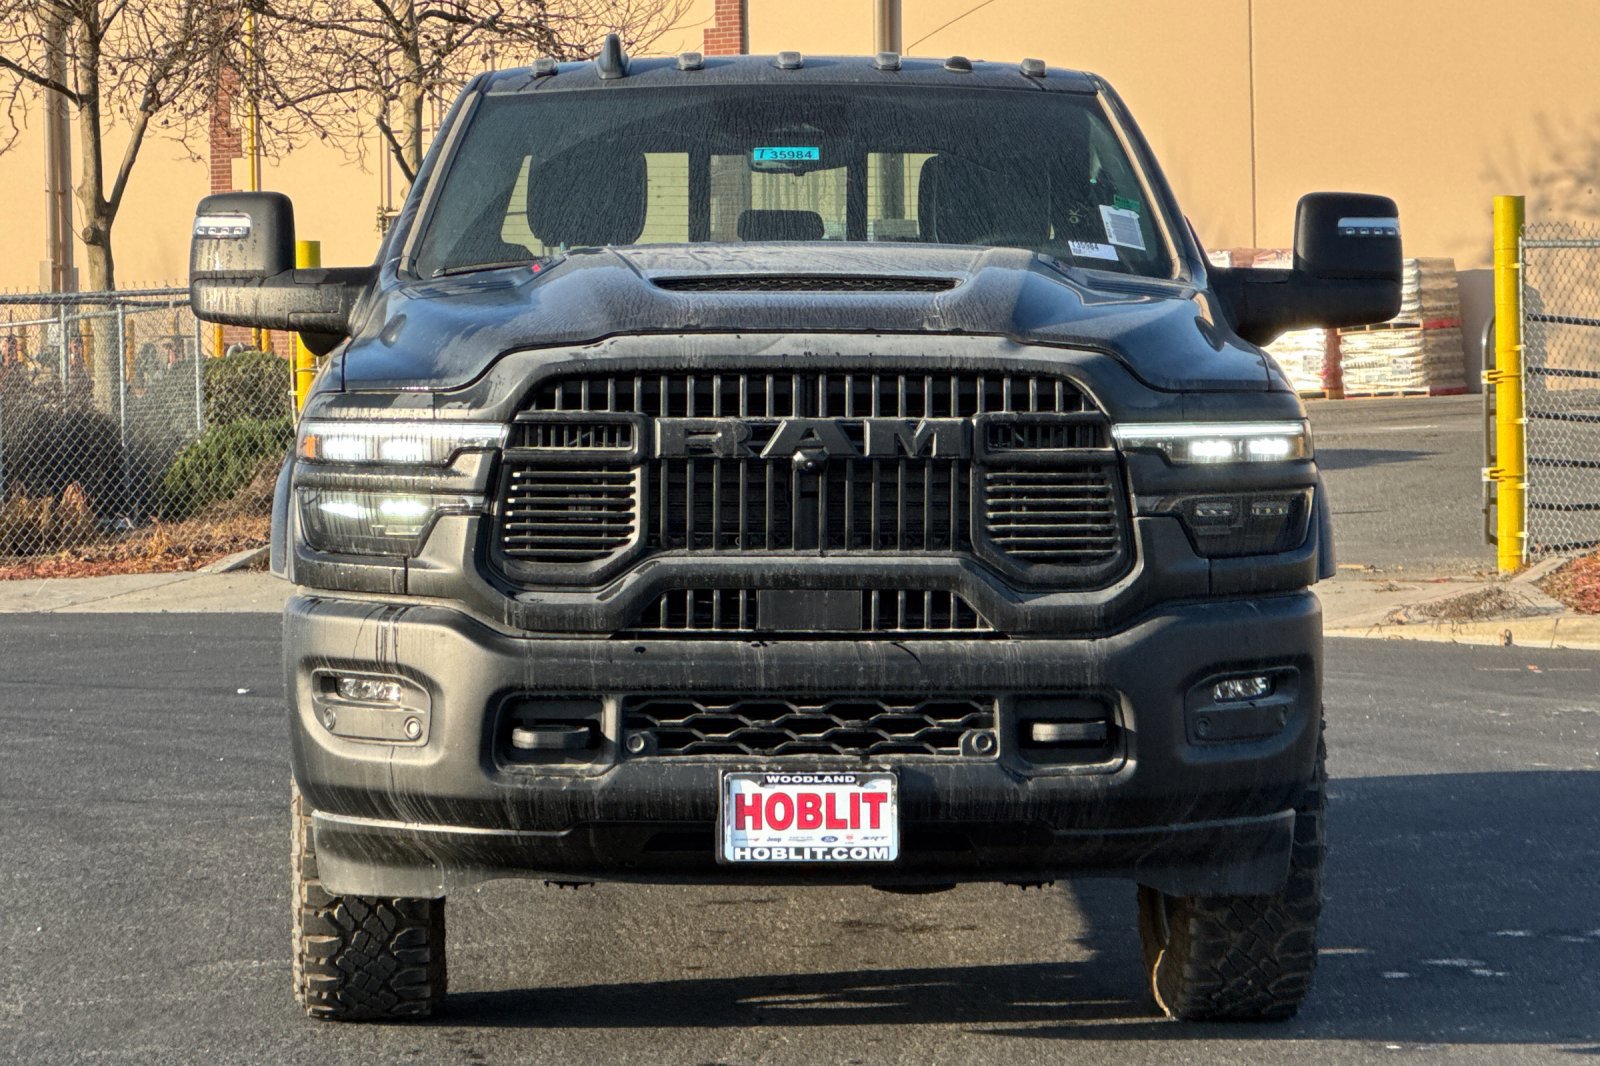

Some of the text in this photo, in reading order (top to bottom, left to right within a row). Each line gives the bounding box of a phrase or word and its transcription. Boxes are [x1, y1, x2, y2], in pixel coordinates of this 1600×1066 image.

[770, 150, 812, 159] 35984
[655, 417, 972, 459] RAM
[766, 775, 856, 784] WOODLAND
[735, 792, 888, 831] HOBLIT
[734, 847, 888, 860] HOBLIT.COM
